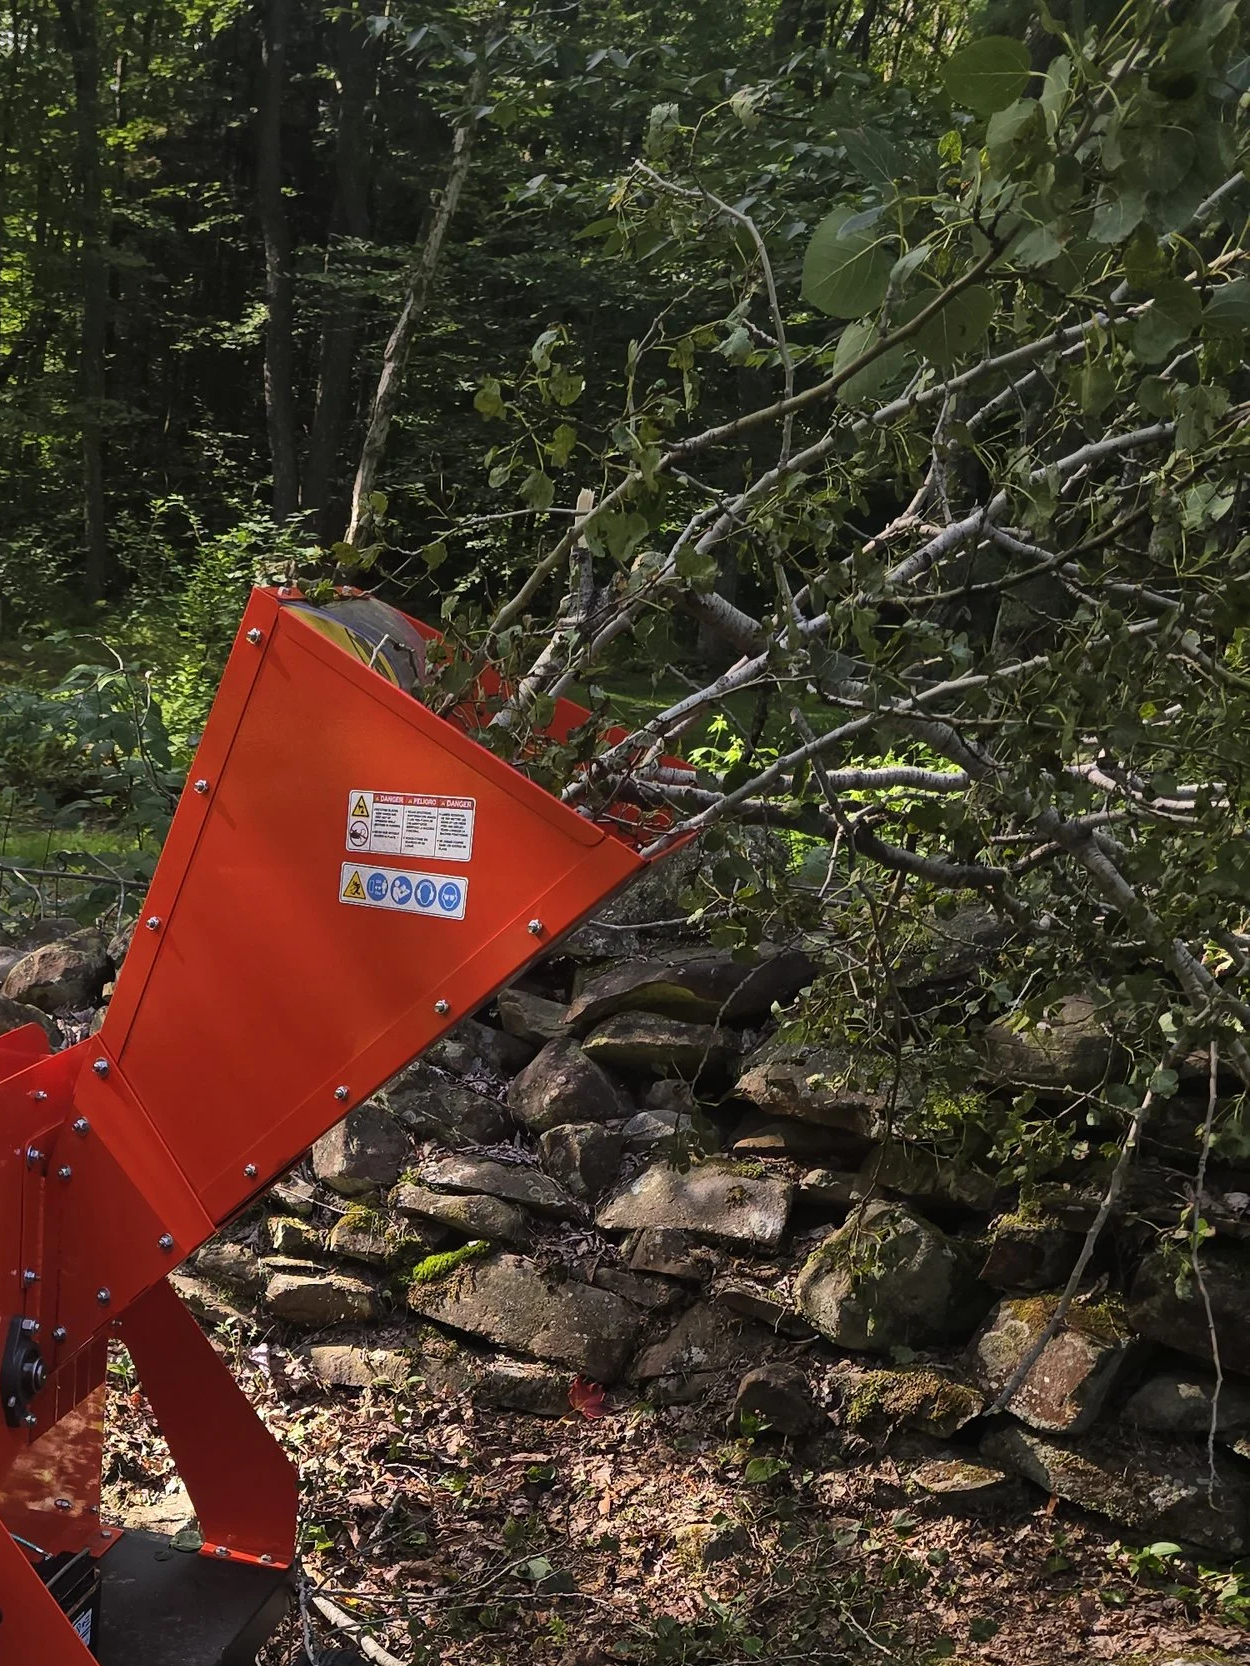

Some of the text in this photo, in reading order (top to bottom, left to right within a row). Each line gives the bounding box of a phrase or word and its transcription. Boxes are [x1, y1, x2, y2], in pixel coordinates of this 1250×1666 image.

[380, 795, 404, 804] DANGER
[413, 797, 437, 806] PELIGRO
[446, 799, 472, 808] DANGER
